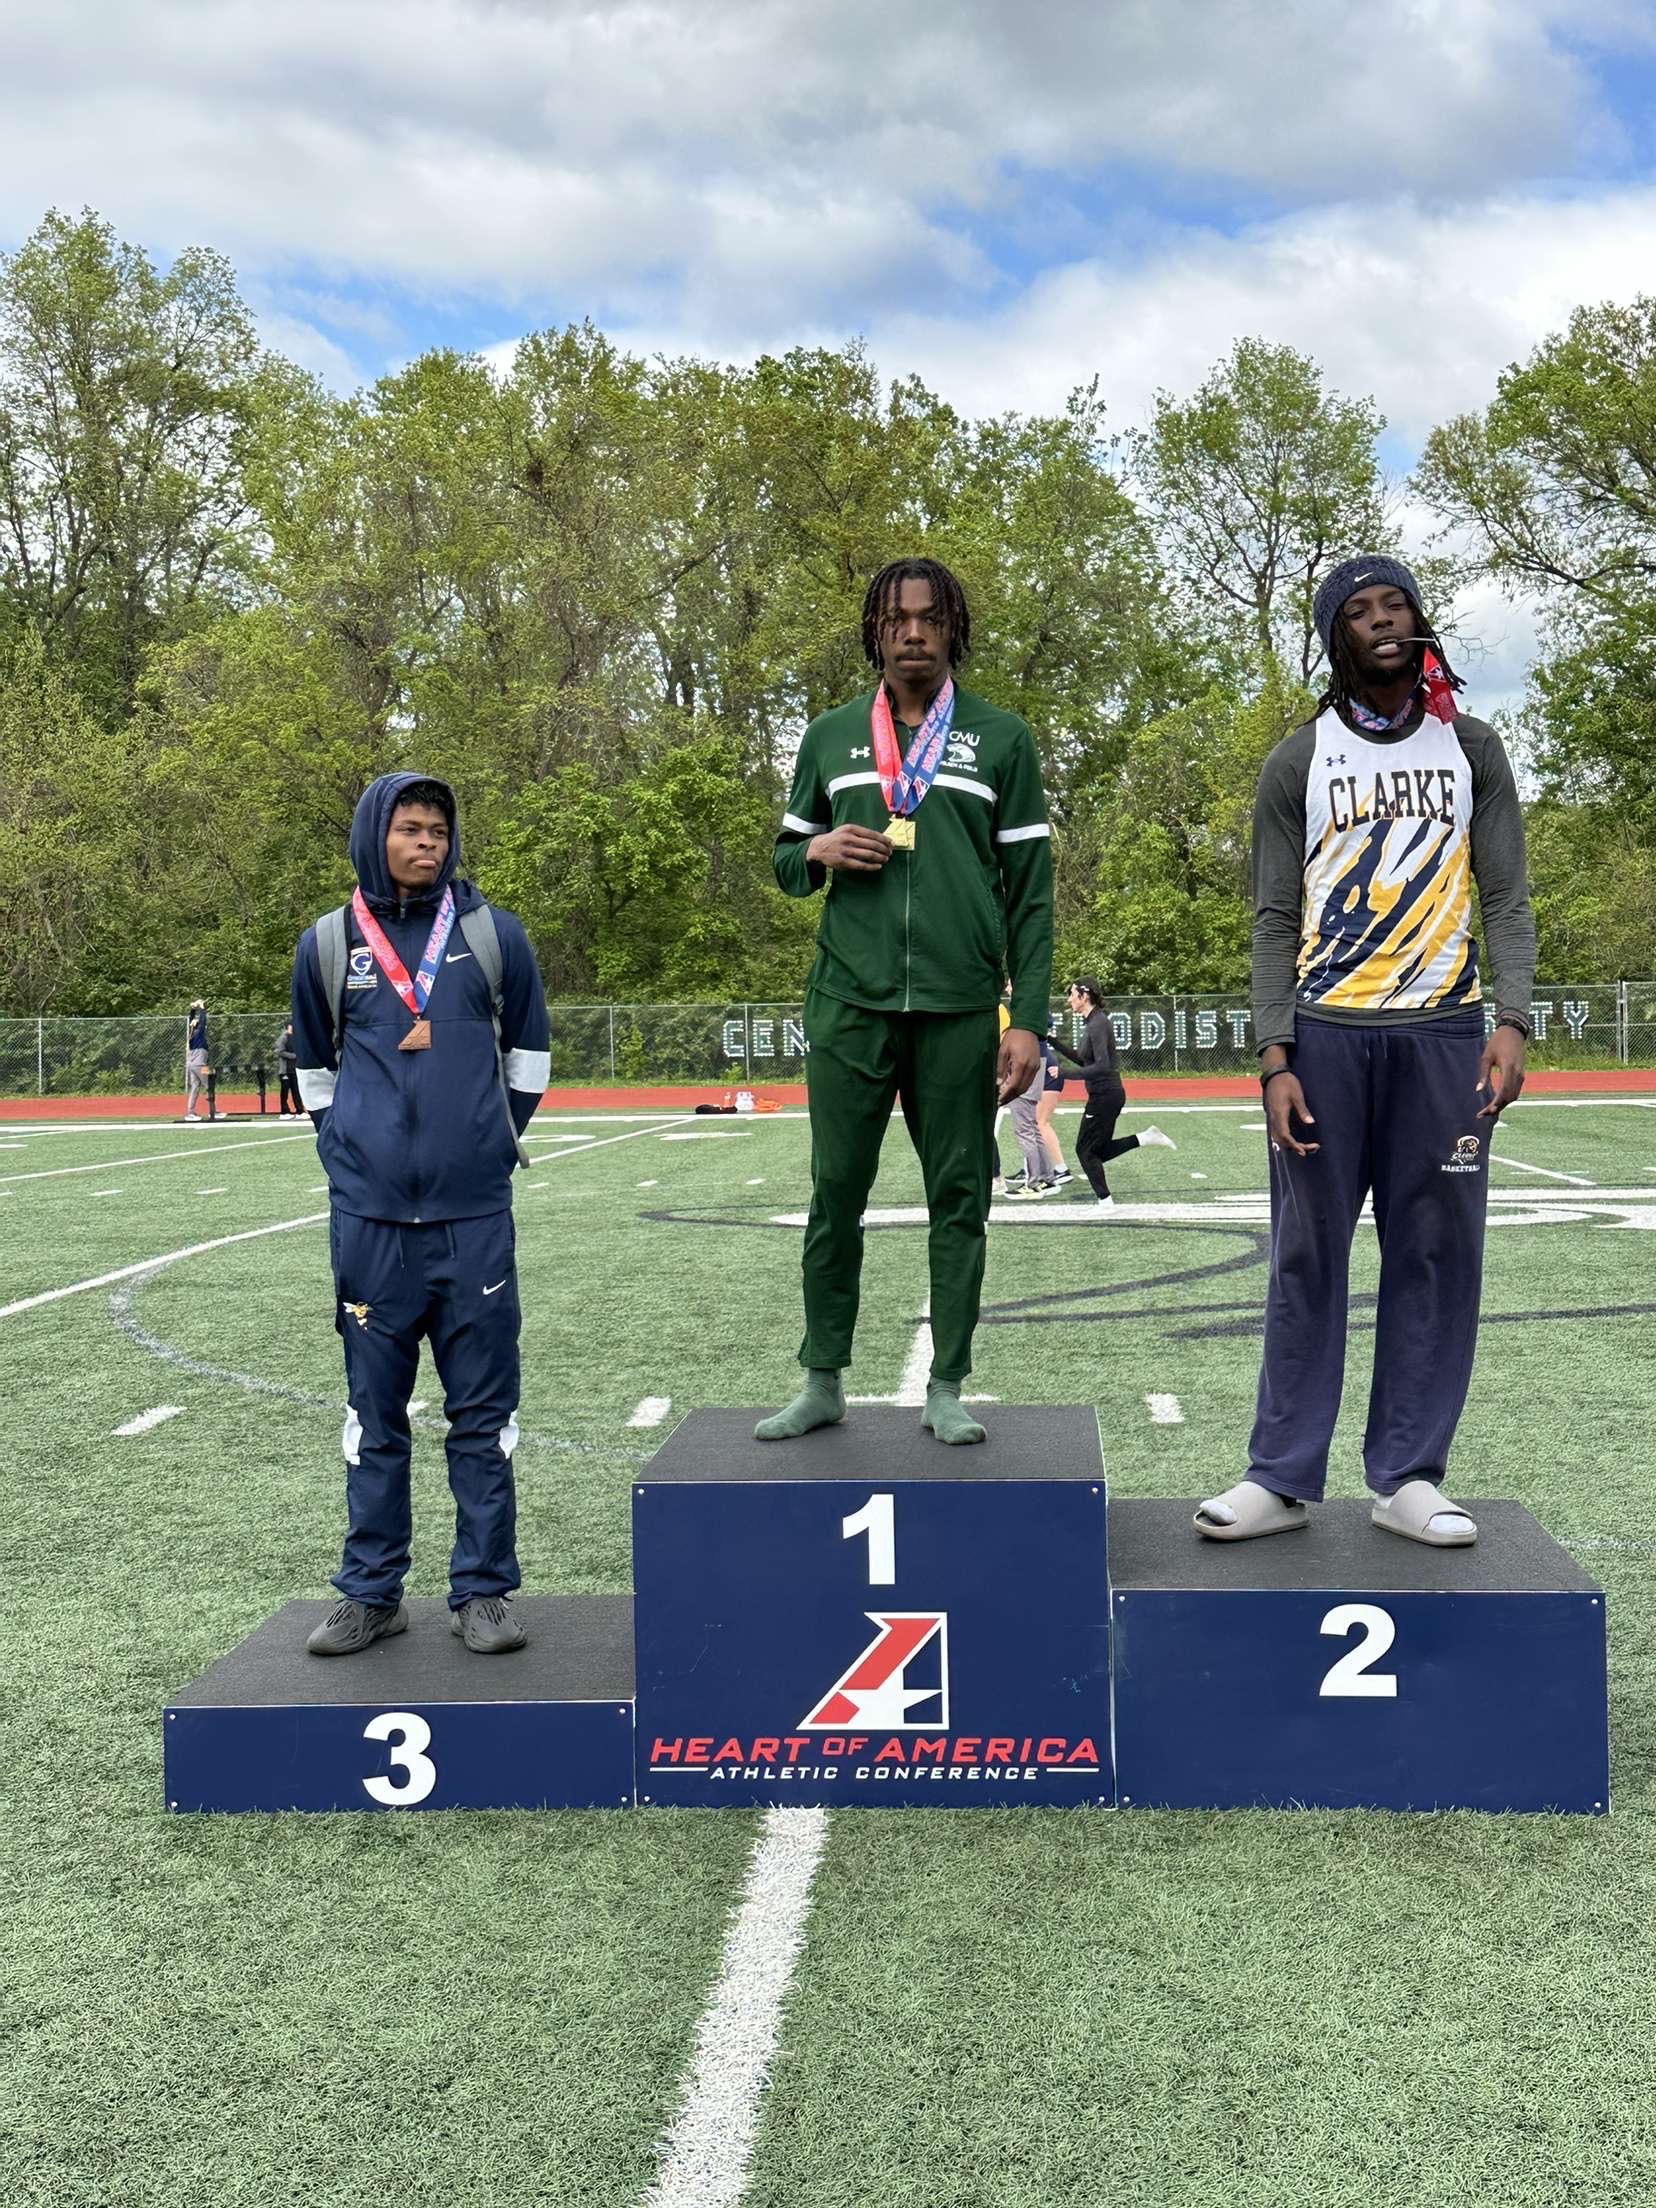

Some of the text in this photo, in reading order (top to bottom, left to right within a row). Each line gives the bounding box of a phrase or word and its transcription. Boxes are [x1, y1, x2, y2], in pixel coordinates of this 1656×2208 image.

[949, 731, 980, 746] CMU
[1328, 769, 1456, 833] CLARKE
[722, 1018, 806, 1058] CEN
[842, 1493, 896, 1585] 1
[1318, 1603, 1398, 1697] 2
[361, 1711, 437, 1806] 3
[650, 1737, 1100, 1764] HEART OF AMERICA
[709, 1766, 1040, 1780] ATHLETIC CONFERENCE
